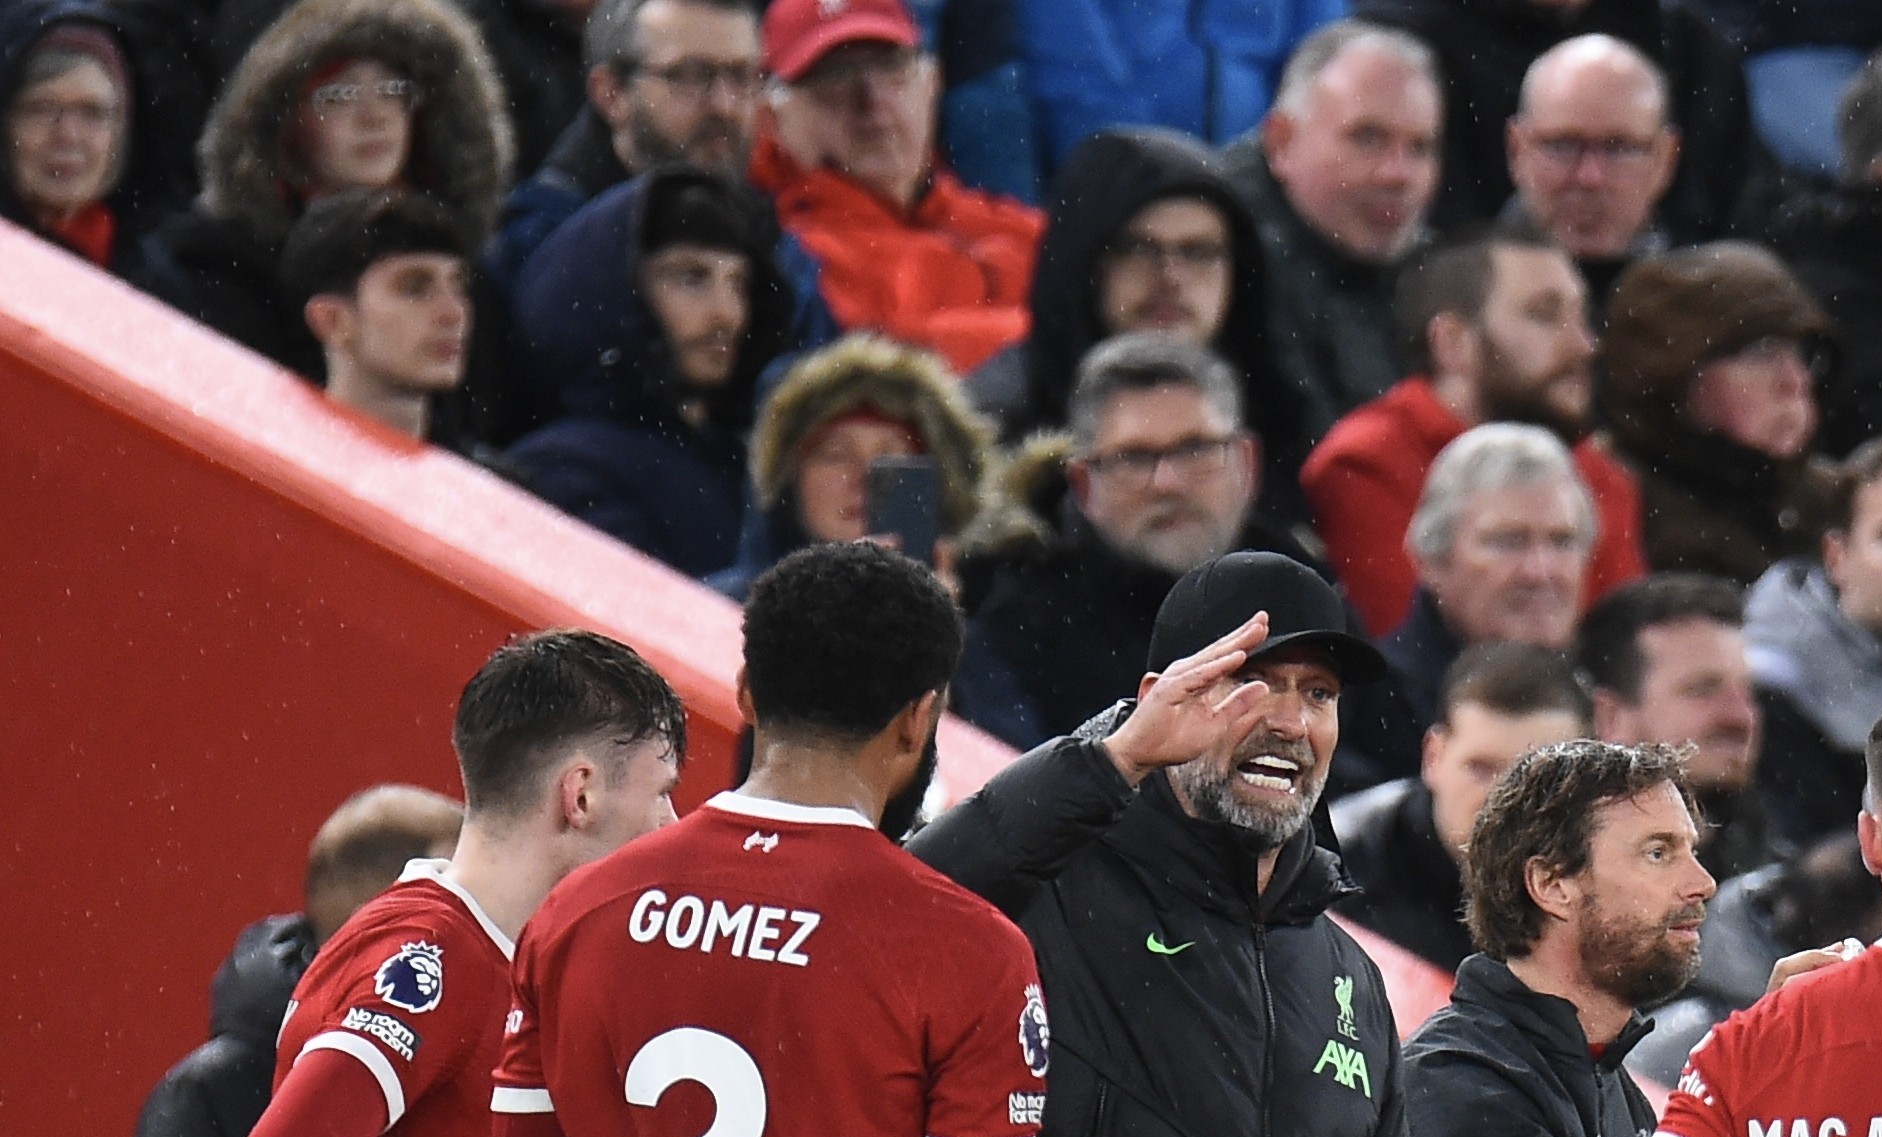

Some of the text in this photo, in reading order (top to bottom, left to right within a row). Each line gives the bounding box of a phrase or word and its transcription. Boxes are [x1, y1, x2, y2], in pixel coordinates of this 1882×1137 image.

[628, 889, 821, 967] GOMEZ
[371, 1013, 415, 1047] room
[1313, 1040, 1371, 1099] AXA
